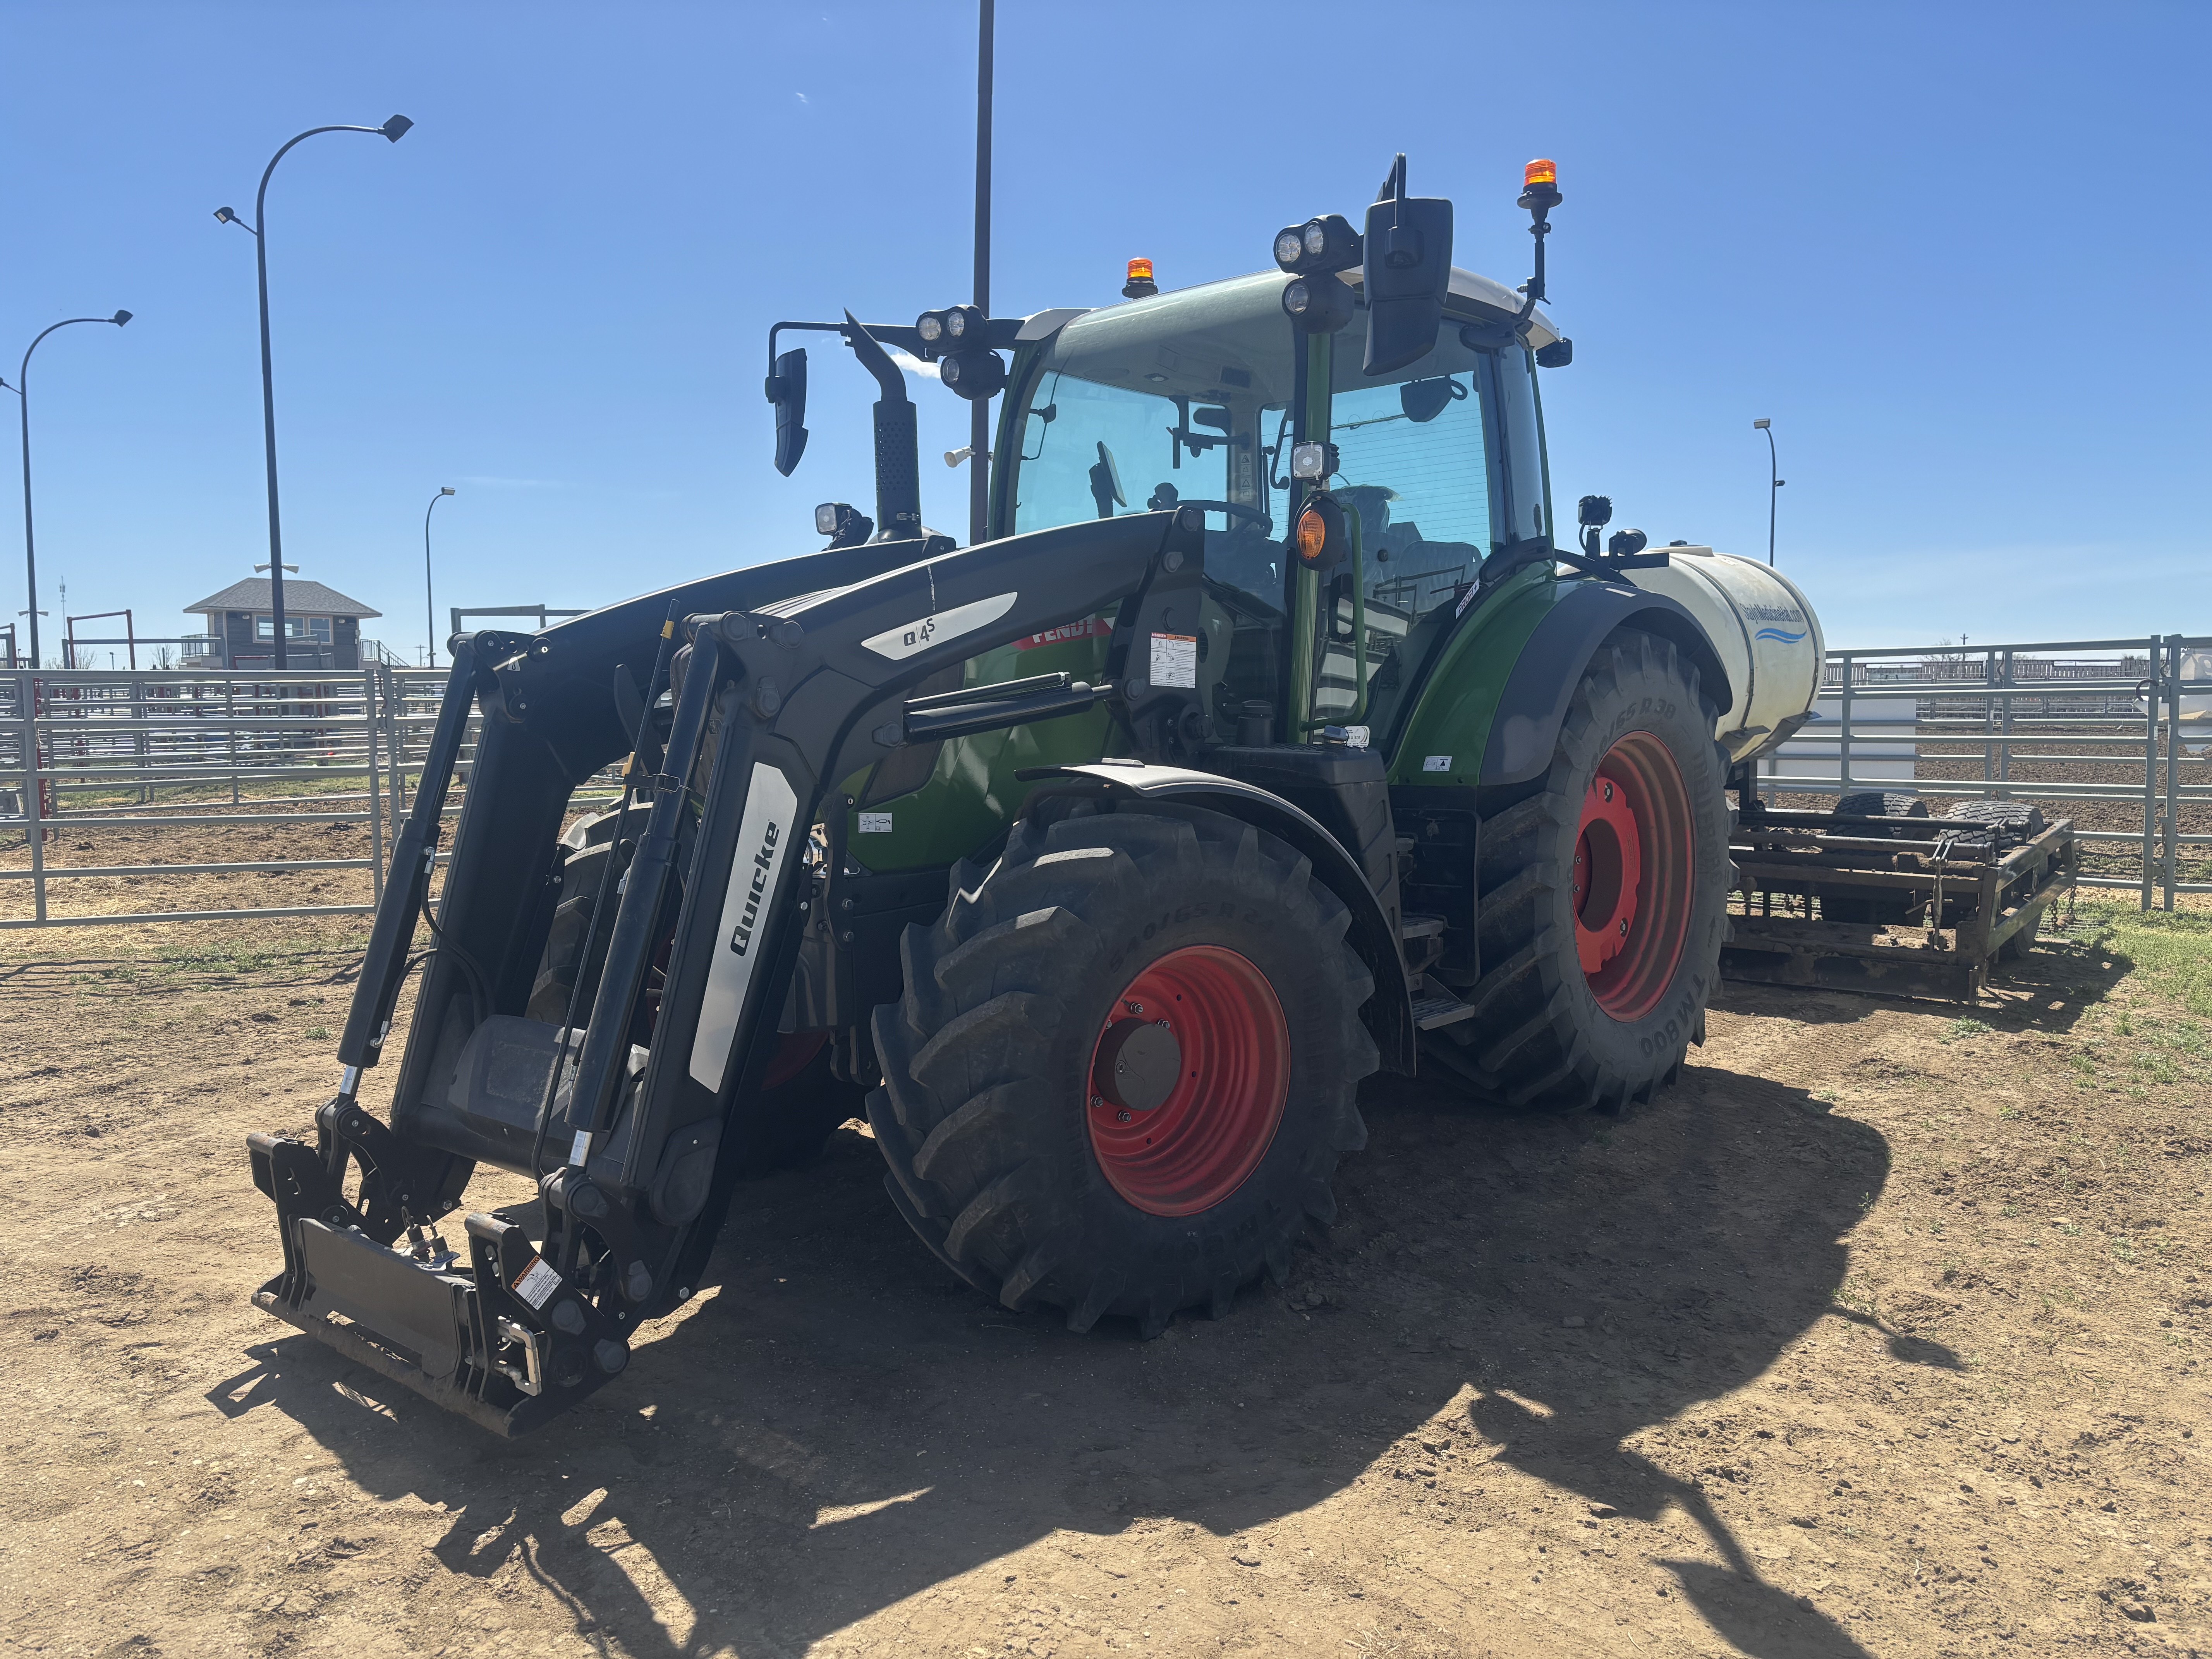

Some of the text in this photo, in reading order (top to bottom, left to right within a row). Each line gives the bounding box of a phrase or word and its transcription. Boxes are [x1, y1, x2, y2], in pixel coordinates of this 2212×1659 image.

[1639, 697, 1653, 715] R
[1654, 698, 1677, 720] 38
[730, 821, 780, 957] Quicke
[1216, 900, 1237, 919] R
[1639, 973, 1706, 1060] TM 800
[518, 1256, 540, 1283] WARNING
